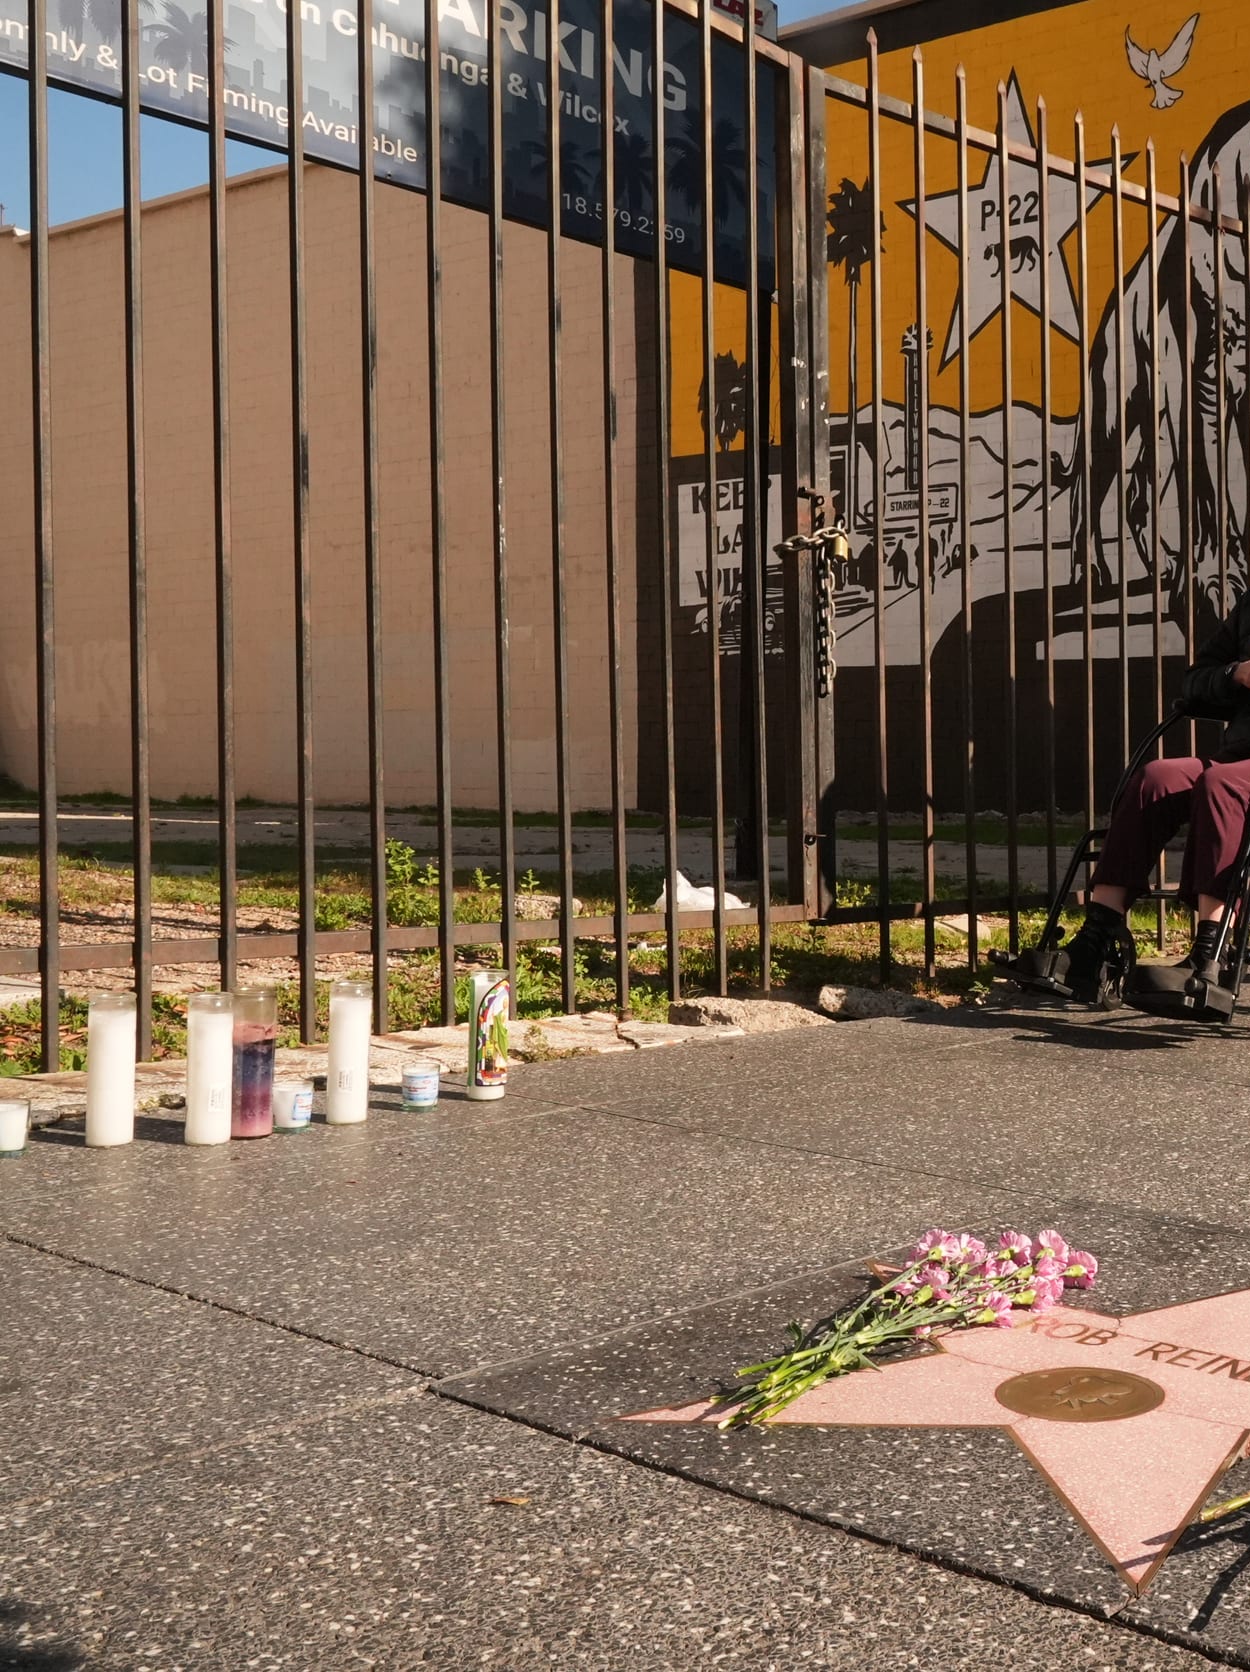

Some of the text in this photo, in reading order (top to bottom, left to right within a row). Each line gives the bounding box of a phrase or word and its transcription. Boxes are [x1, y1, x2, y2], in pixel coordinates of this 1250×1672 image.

[389, 0, 688, 112] ARKING
[96, 45, 119, 70] &
[187, 72, 290, 127] Fming
[302, 110, 418, 162] Avaible
[507, 72, 528, 100] &
[981, 190, 1039, 232] P-22
[1029, 1314, 1118, 1346] ROB
